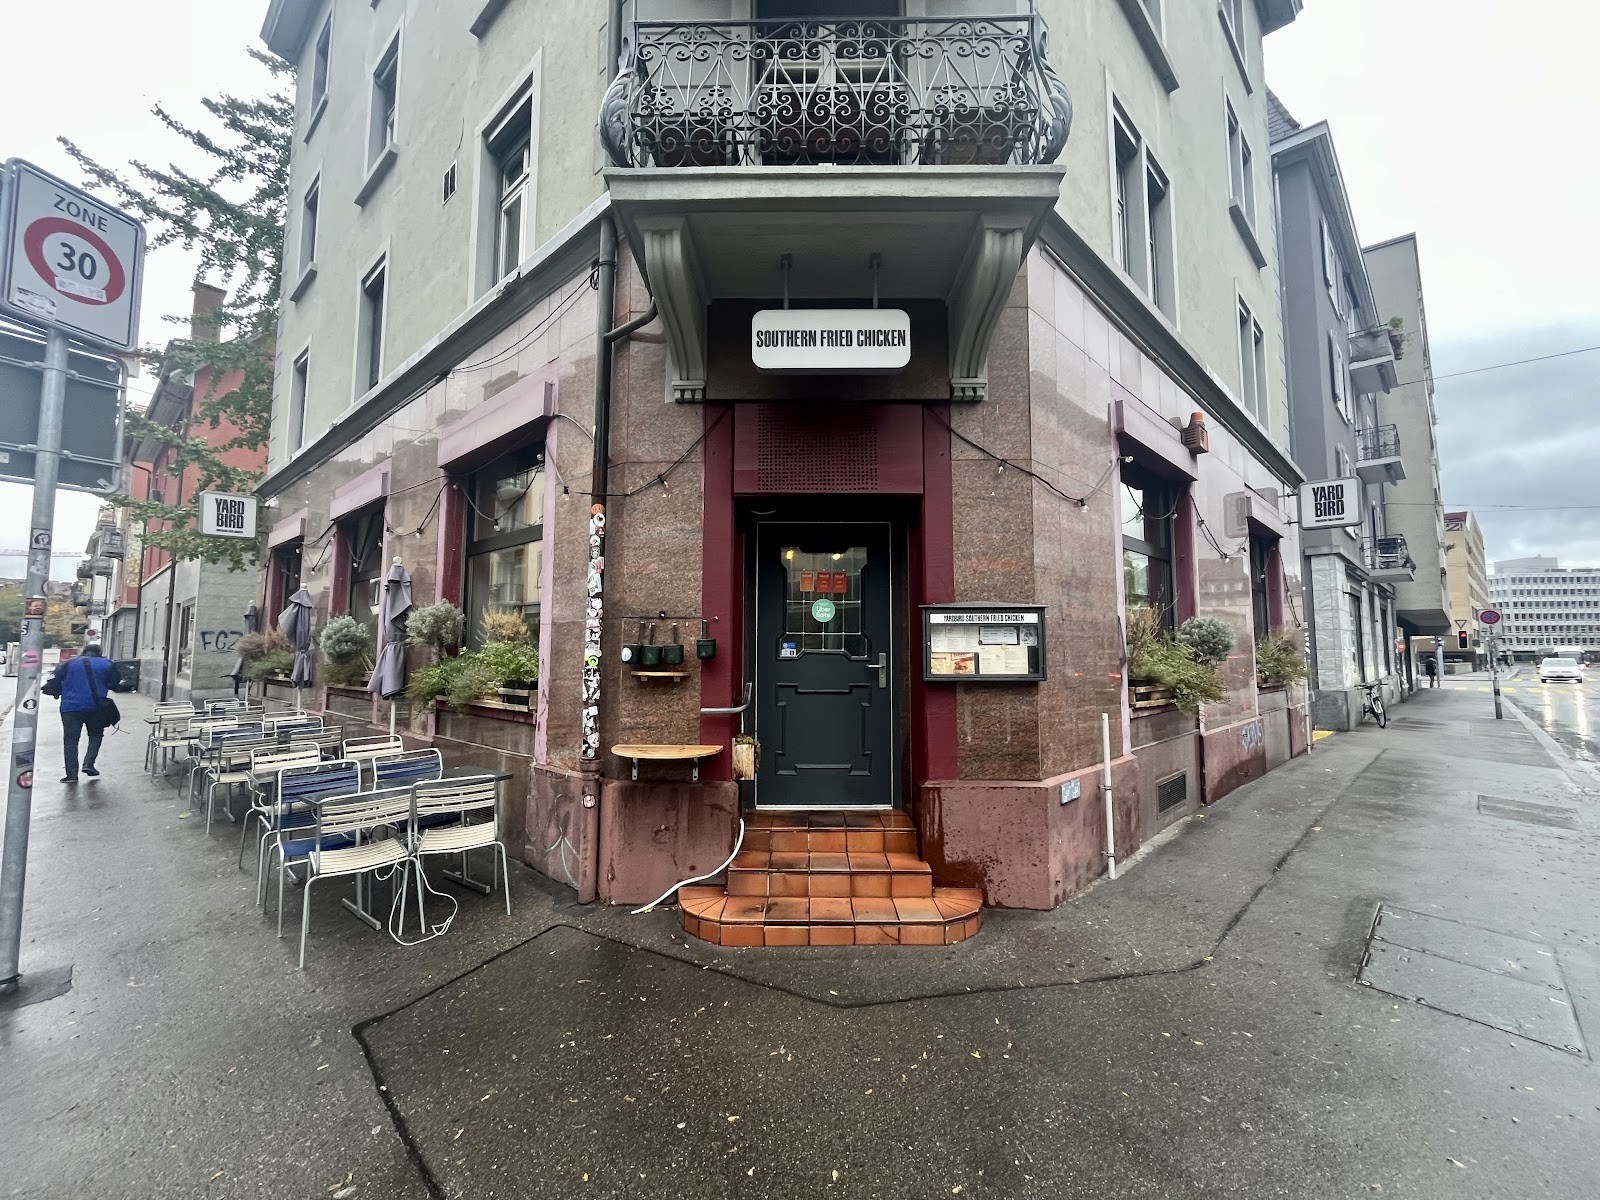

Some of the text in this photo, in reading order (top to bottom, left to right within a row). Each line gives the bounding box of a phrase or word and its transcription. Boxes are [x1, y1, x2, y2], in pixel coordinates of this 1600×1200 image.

[54, 193, 107, 233] ZONE
[57, 242, 97, 280] 30
[756, 329, 906, 347] SOUTHERN FRIED CHICKEN
[1312, 484, 1344, 502] YARD
[215, 498, 245, 515] YARD
[1315, 500, 1345, 517] BIRD
[216, 513, 244, 529] BIRD
[966, 614, 990, 622] SOUTHERN
[991, 614, 1004, 622] FRIED
[1005, 614, 1025, 622] CHICKEN
[200, 629, 243, 650] FCZ
